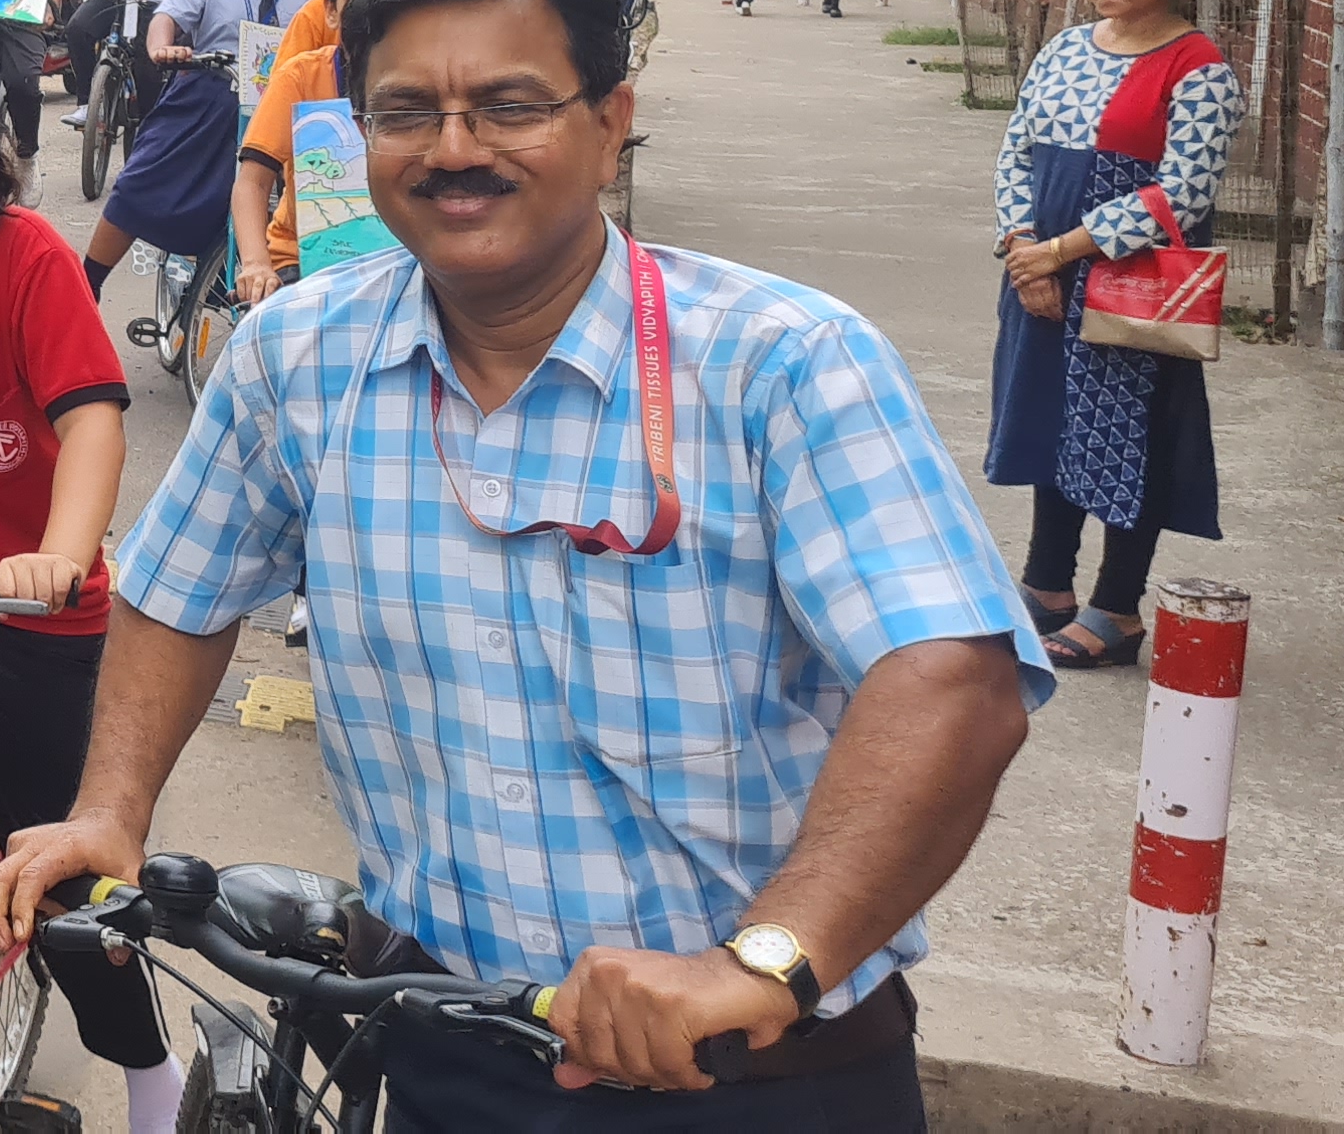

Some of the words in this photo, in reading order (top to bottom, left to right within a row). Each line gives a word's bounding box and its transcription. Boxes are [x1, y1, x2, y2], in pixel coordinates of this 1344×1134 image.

[640, 271, 657, 341] VIDYAPITH
[646, 345, 662, 400] TISSUES
[649, 405, 665, 464] TRIBENI
